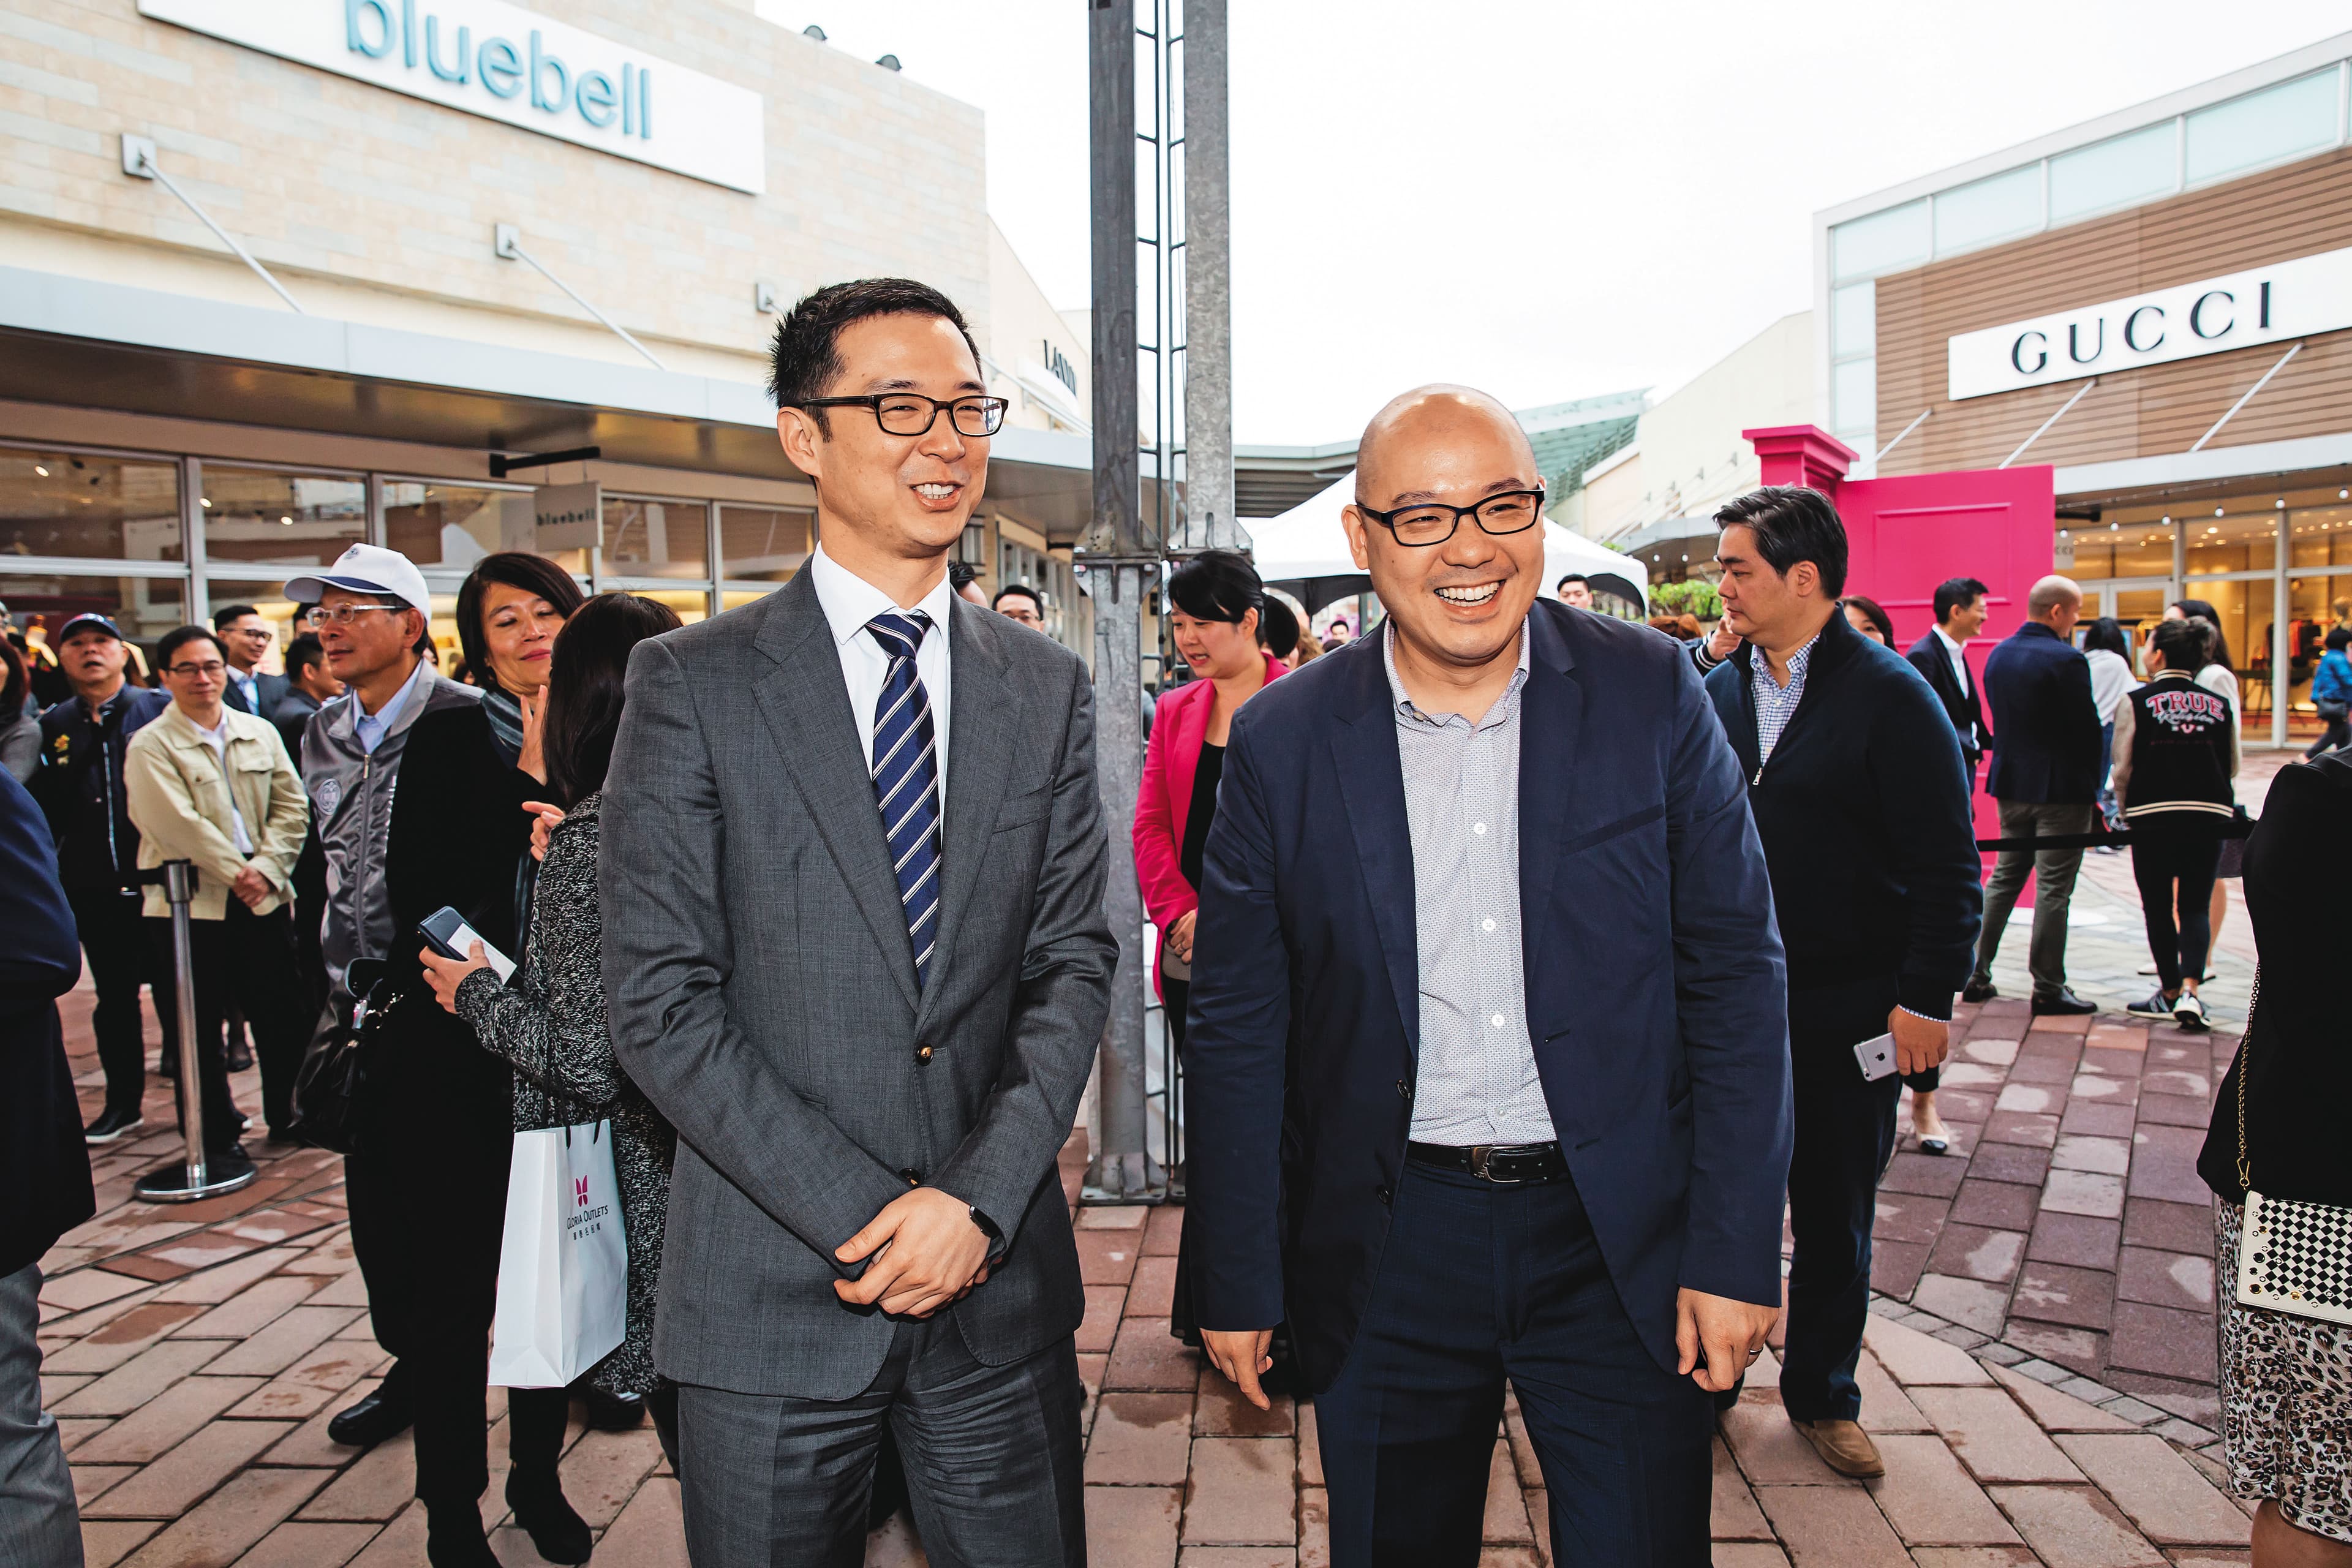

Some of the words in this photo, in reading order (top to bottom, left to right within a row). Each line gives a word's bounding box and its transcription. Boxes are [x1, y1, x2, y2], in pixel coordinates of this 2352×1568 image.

[346, 0, 651, 140] bluebell
[2011, 281, 2270, 374] GUCCI
[536, 508, 596, 526] bluebell
[2145, 691, 2225, 722] TRUE
[584, 1205, 608, 1222] OUTLETS
